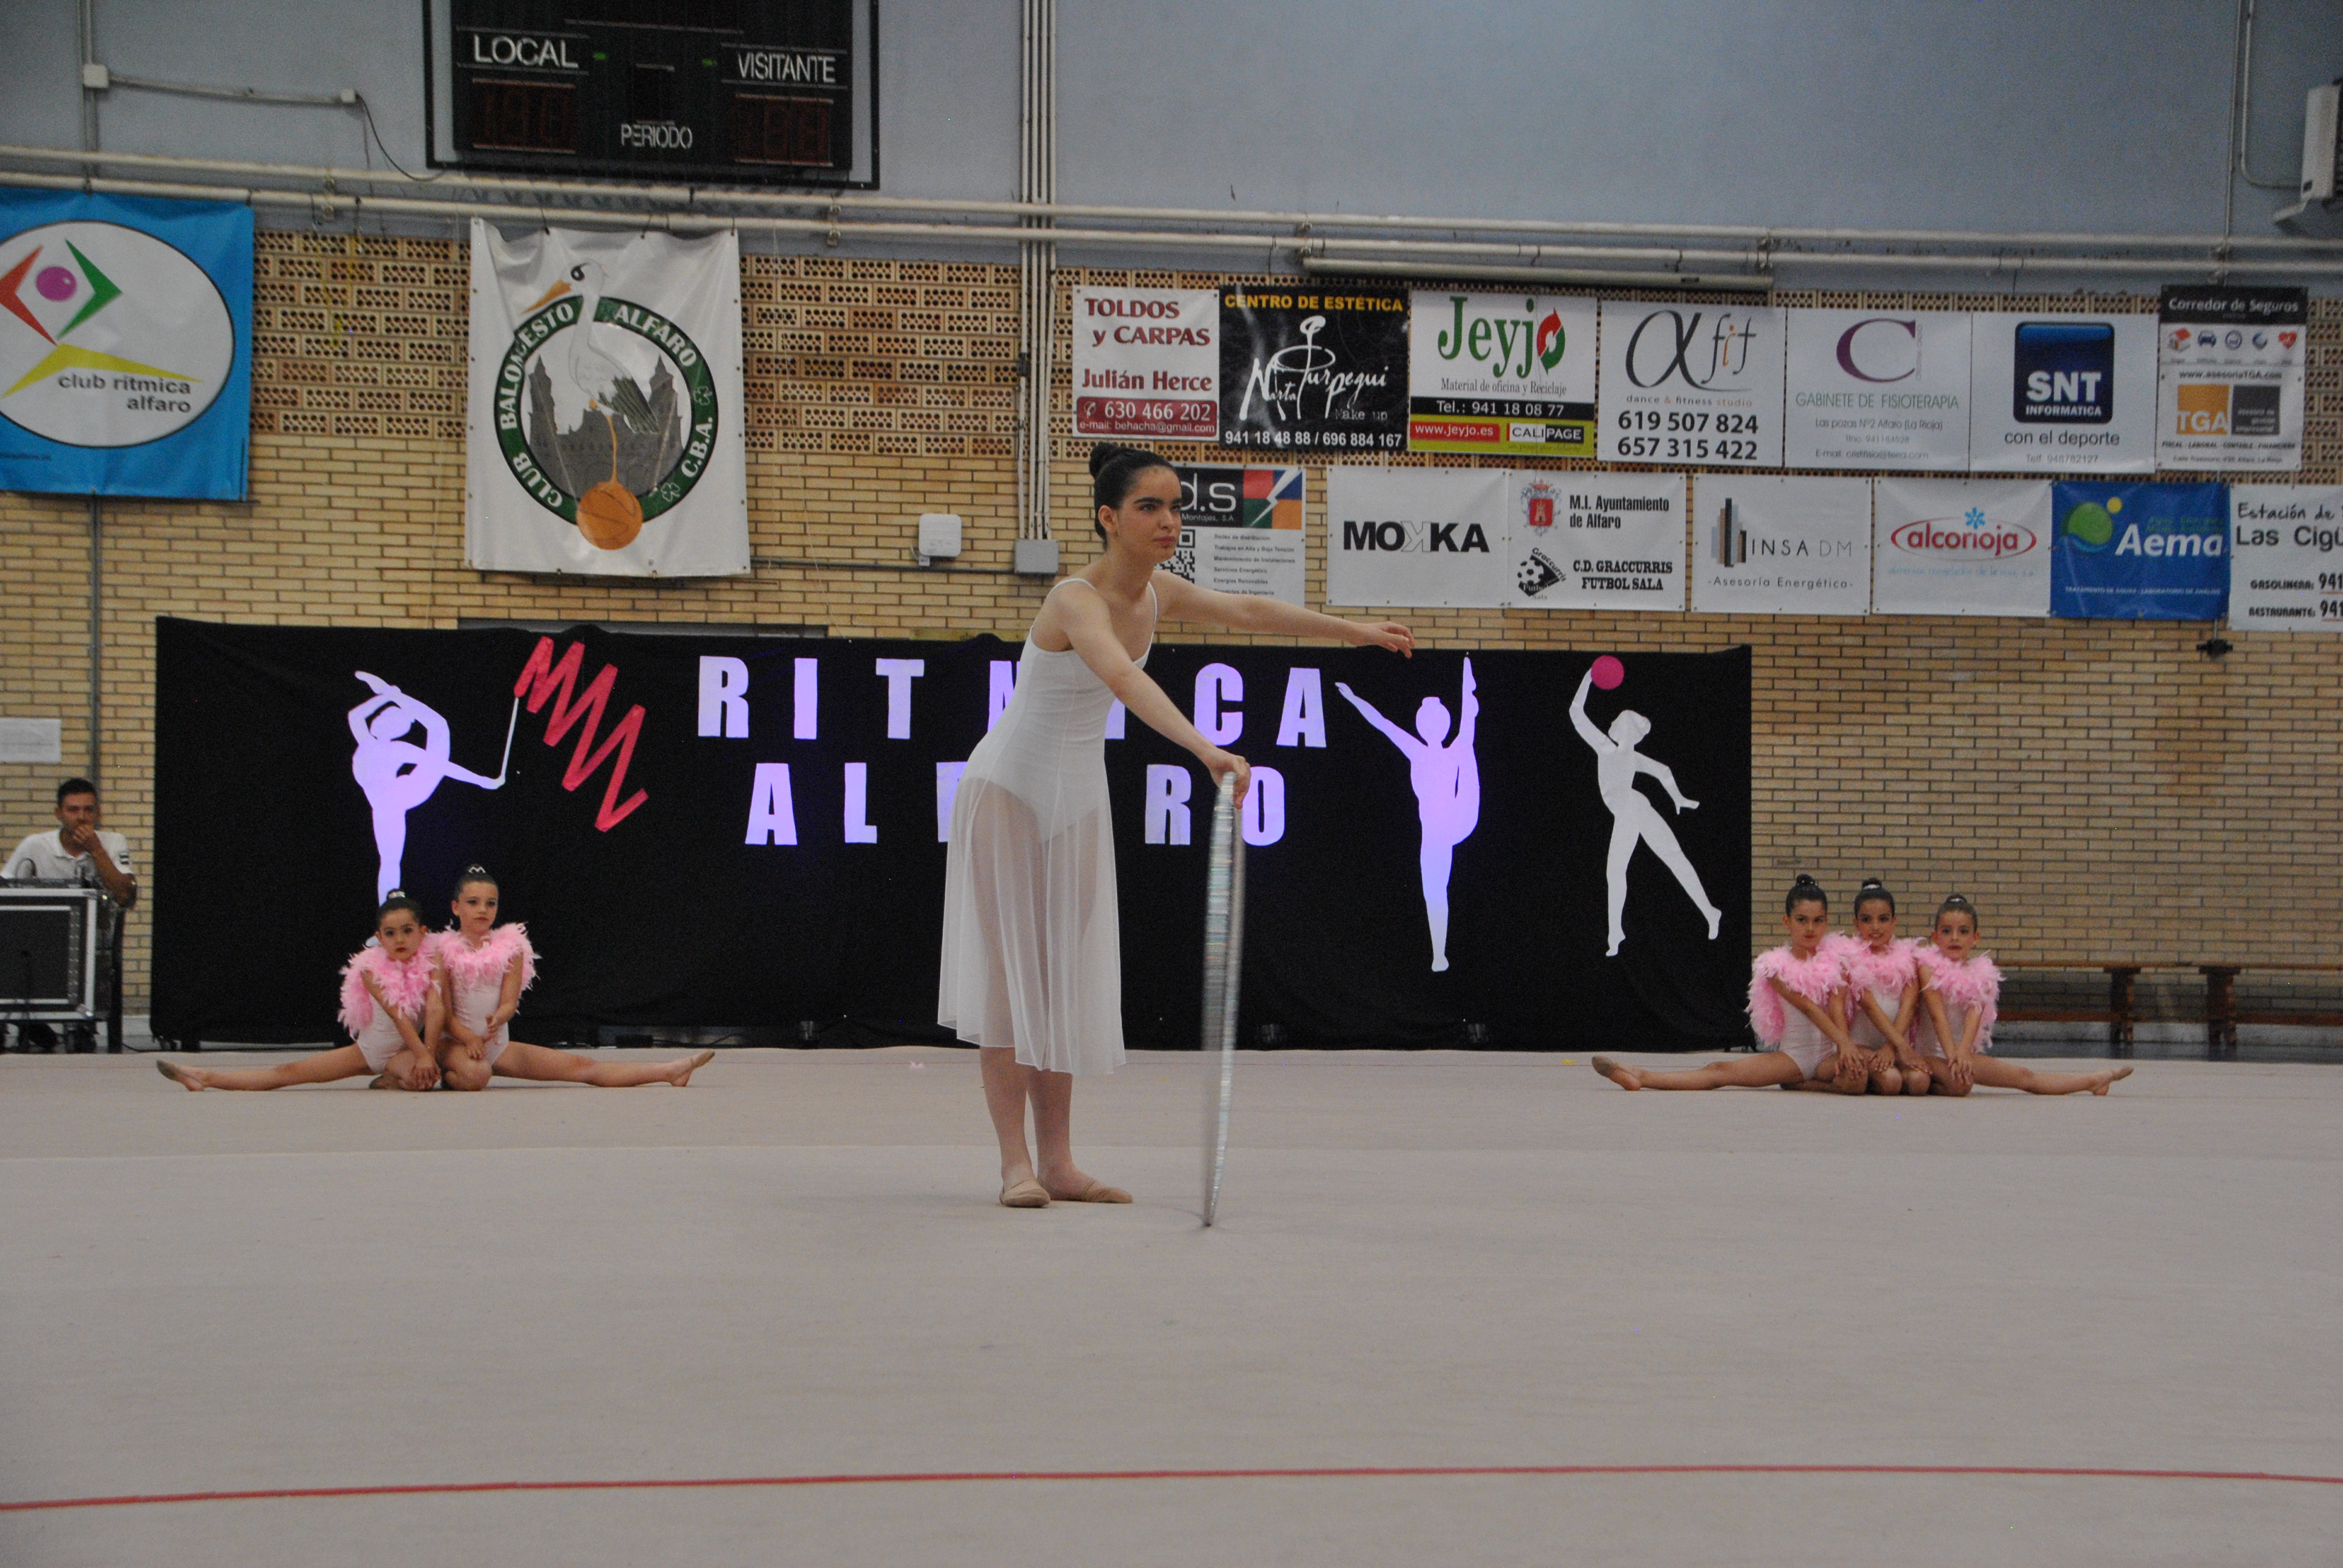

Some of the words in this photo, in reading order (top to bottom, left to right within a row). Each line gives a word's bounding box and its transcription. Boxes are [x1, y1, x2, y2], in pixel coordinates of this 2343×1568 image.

[472, 34, 579, 70] LOCAL
[738, 53, 836, 84] VISITANTE
[620, 123, 693, 149] PERIODO
[1084, 298, 1180, 319] TOLDOS
[1225, 295, 1293, 309] CENTRO
[1298, 296, 1319, 309] DE
[2169, 298, 2228, 311] Corredor
[2230, 298, 2246, 312] de
[2249, 299, 2298, 315] Seguros
[1092, 330, 1106, 347] y
[1114, 326, 1210, 345] CARPAS
[1437, 295, 1565, 379] Jeyjo
[58, 373, 105, 389] club
[113, 376, 191, 394] ritmica
[1082, 368, 1144, 389] Julián
[1153, 371, 1212, 391] Herce
[1441, 377, 1477, 391] Material
[1480, 379, 1490, 391] de
[1492, 380, 1520, 393] oficina
[1523, 385, 1528, 396] y
[1530, 381, 1567, 397] Reciclaje
[2027, 370, 2102, 403] SNT
[127, 396, 191, 414] alfaro
[512, 452, 563, 508] CLUB
[614, 304, 698, 368] ALFARO
[1436, 400, 1466, 413] Tel.:
[1472, 402, 1496, 414] 941
[1504, 403, 1520, 415] 18
[1525, 403, 1542, 416] 08
[1547, 405, 1564, 417] 77
[1627, 394, 1659, 404] dance
[1665, 396, 1671, 404] &
[1676, 395, 1712, 405] fitness
[1717, 397, 1752, 407] studio
[1796, 393, 1854, 408] GABINETE
[1859, 394, 1874, 408] DE
[2025, 405, 2102, 416] INFORMATICA
[1104, 401, 1136, 419] 630
[1142, 402, 1173, 420] 466
[1180, 403, 1211, 422] 202
[2178, 411, 2228, 431] TGA
[1080, 420, 1112, 430] e-mail:
[1115, 421, 1215, 433] behacha@gmail.com
[1415, 425, 1493, 437] www.jeyjo.es
[1618, 411, 1660, 430] 619
[1668, 412, 1709, 432] 507
[1716, 414, 1758, 434] 824
[1815, 419, 1829, 427] Las
[1878, 419, 1902, 428] Alfaro
[681, 417, 713, 477] C.B.A.
[1225, 431, 1248, 444] 941
[1254, 431, 1270, 445] 18
[1274, 431, 1290, 445] 48
[1295, 431, 1311, 445] 88
[1323, 433, 1346, 446] 696
[1351, 433, 1374, 446] 884
[1378, 433, 1402, 447] 167
[1617, 436, 1660, 457] 657
[1667, 438, 1709, 459] 315
[1715, 440, 1757, 460] 422
[2004, 432, 2033, 444] con
[2039, 430, 2053, 444] el
[2059, 431, 2120, 448] deporte
[1570, 495, 1591, 510] M.I.
[1596, 495, 1670, 512] Ayuntamiento
[2238, 502, 2306, 519] Estación
[2315, 505, 2335, 520] de
[1570, 514, 1582, 528] de
[1587, 514, 1621, 529] Alfaro
[1907, 520, 2018, 557] alcorioja
[2115, 523, 2223, 557] Aema
[2236, 525, 2279, 546] Las
[1752, 538, 1809, 556] INSA
[1820, 540, 1852, 557] DM
[1573, 560, 1593, 572] C.D.
[1596, 561, 1673, 573] GRACCURRIS
[1582, 577, 1630, 590] FUTBOL
[1632, 578, 1663, 590] SALA
